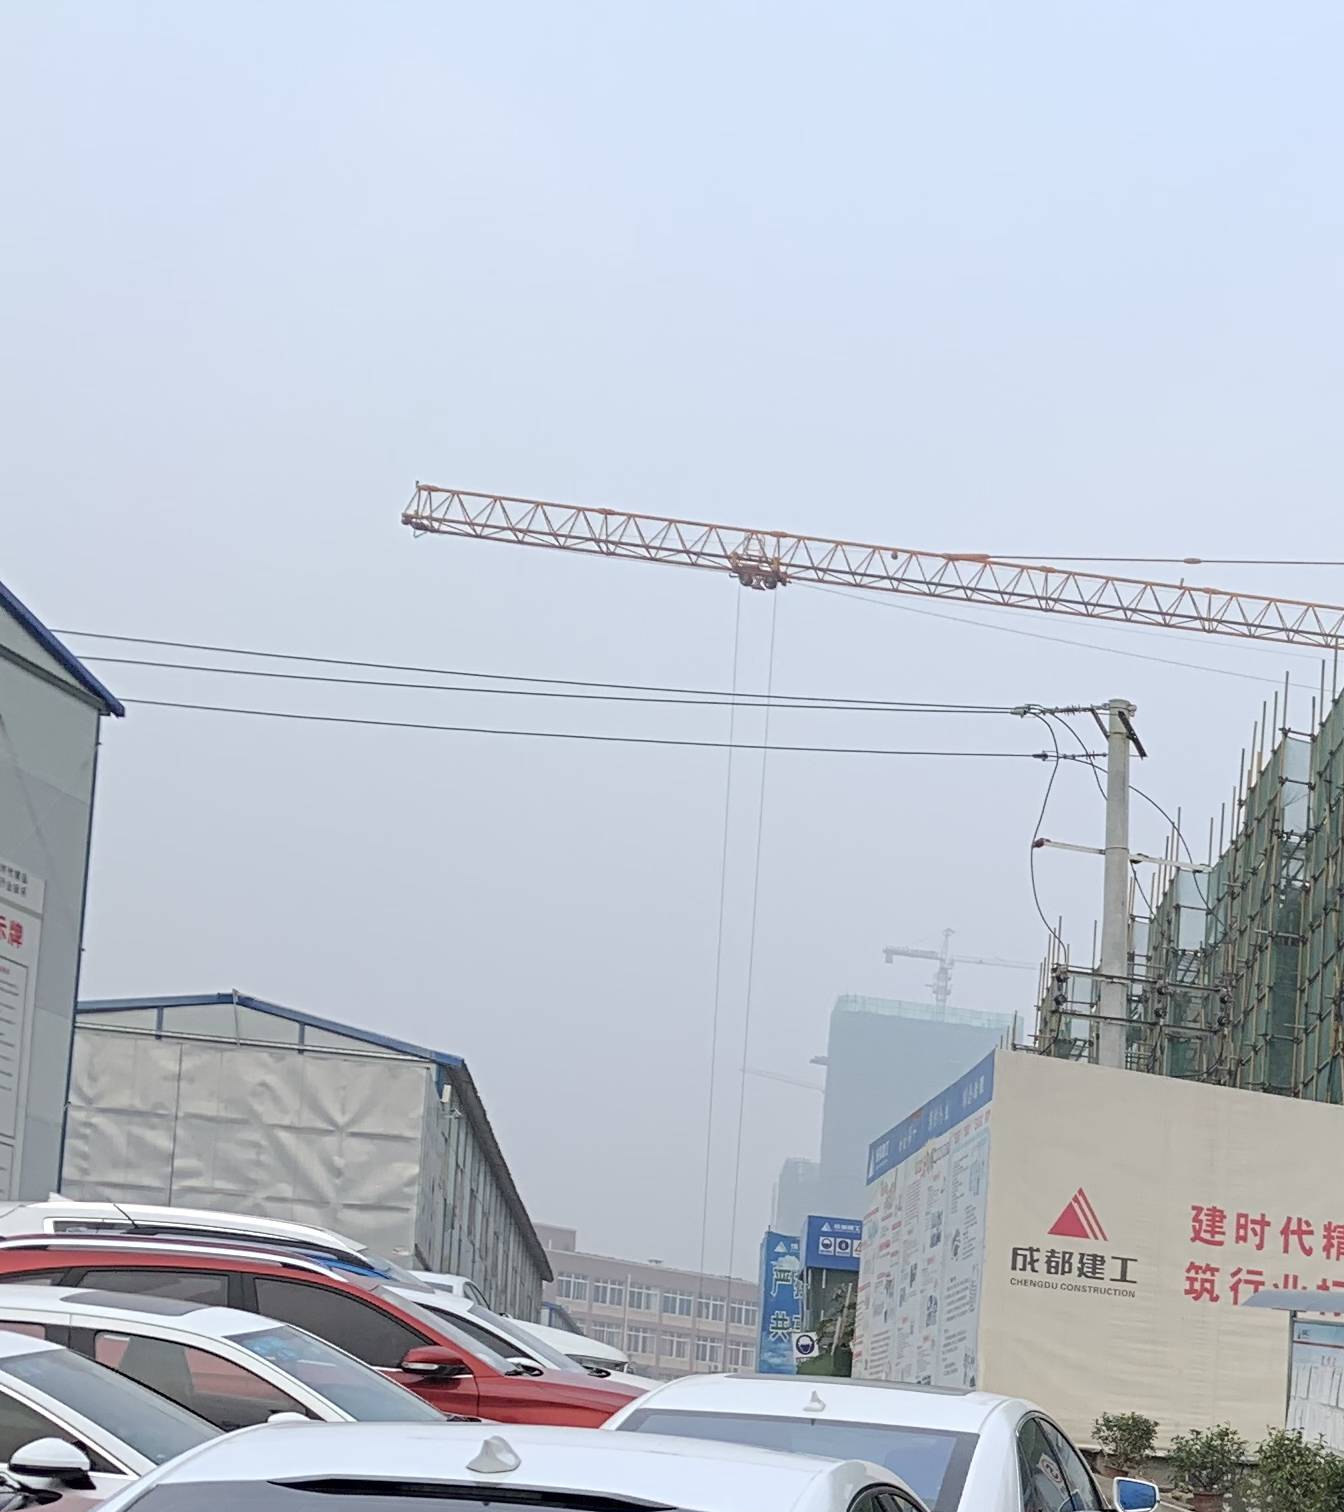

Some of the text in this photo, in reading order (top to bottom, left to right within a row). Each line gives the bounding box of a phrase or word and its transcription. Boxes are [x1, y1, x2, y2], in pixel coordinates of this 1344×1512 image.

[1010, 1246, 1138, 1284] 成都建工
[1010, 1277, 1136, 1298] CHENGDU CONSTRUCTION
